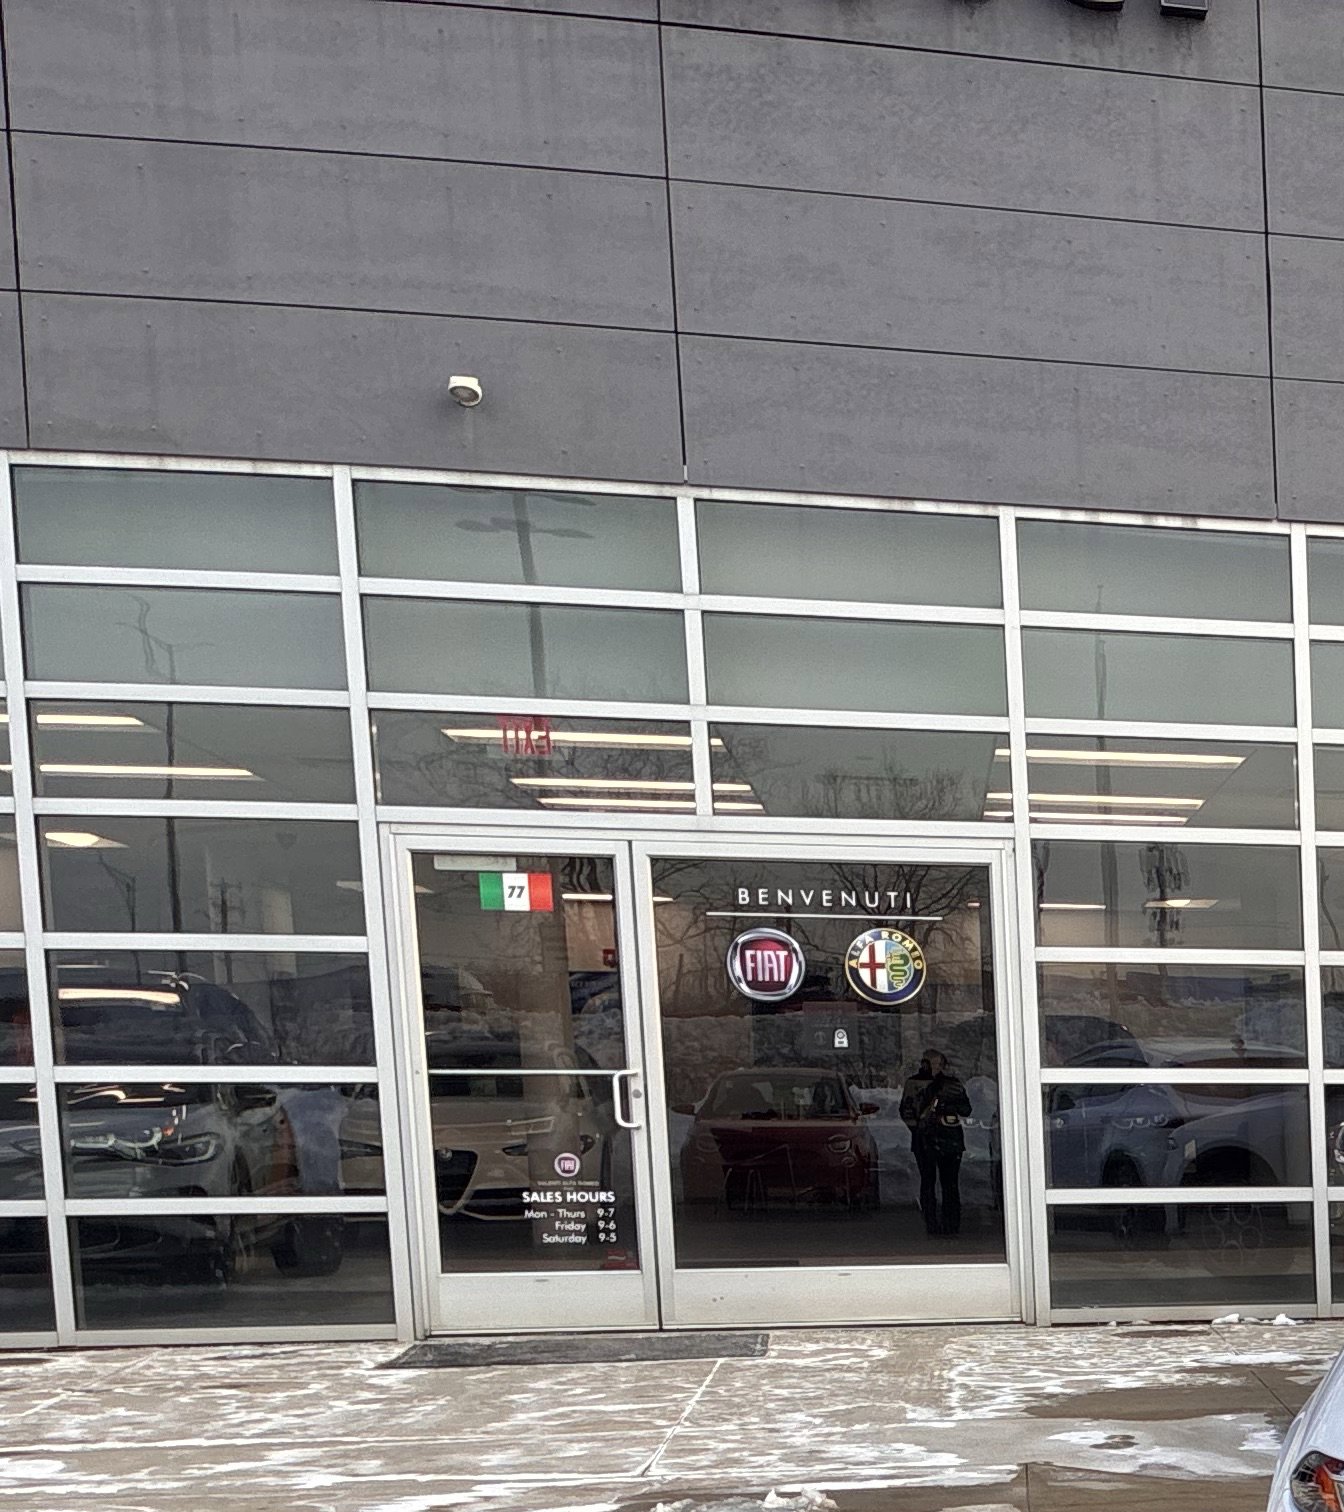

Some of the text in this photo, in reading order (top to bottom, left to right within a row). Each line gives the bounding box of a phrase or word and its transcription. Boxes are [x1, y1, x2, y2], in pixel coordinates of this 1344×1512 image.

[507, 885, 526, 899] 77
[738, 887, 912, 909] BENVENUTI
[848, 930, 923, 970] ALFA ROMEO
[744, 949, 789, 982] FIAT
[522, 1191, 616, 1203] SALES HOURS
[523, 1208, 548, 1219] Mon
[557, 1208, 586, 1219] Thurs
[555, 1221, 587, 1232] Friday
[542, 1233, 588, 1245] Saturday
